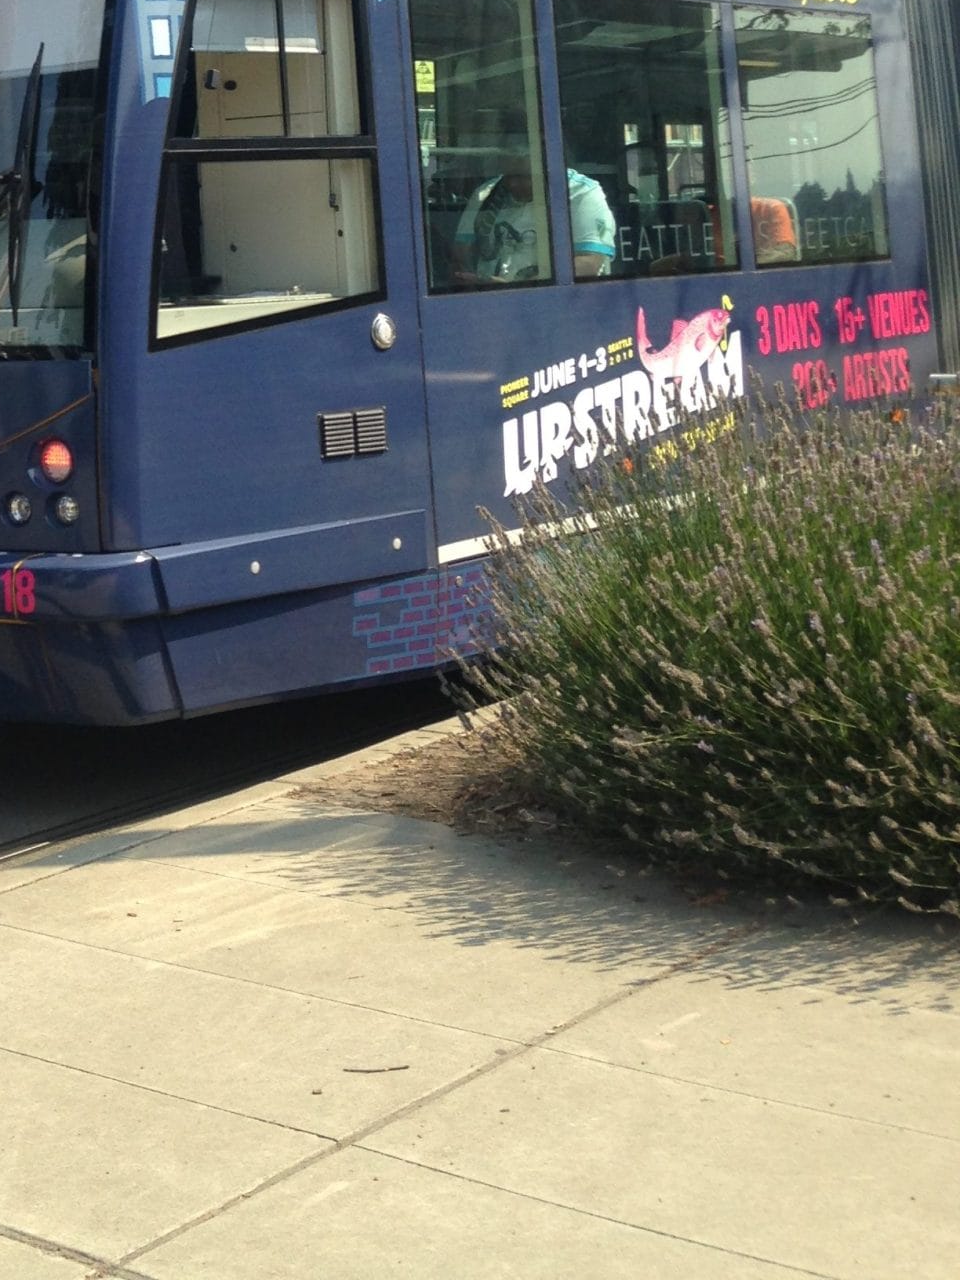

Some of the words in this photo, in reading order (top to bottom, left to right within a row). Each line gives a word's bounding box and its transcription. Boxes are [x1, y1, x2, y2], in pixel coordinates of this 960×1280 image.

[618, 223, 716, 261] EATTLE
[755, 306, 771, 356] 3
[773, 300, 822, 353] DAYS
[834, 296, 866, 344] 15+
[867, 289, 931, 339] VENUES
[607, 336, 633, 354] SEATTLE
[609, 349, 633, 365] 2018
[500, 376, 529, 395] PIONEER
[531, 358, 576, 398] JUNE
[578, 347, 607, 378] 1-3
[843, 347, 911, 401] ARTISTS
[502, 390, 529, 408] SQUARE
[503, 330, 744, 497] UPSTREAM
